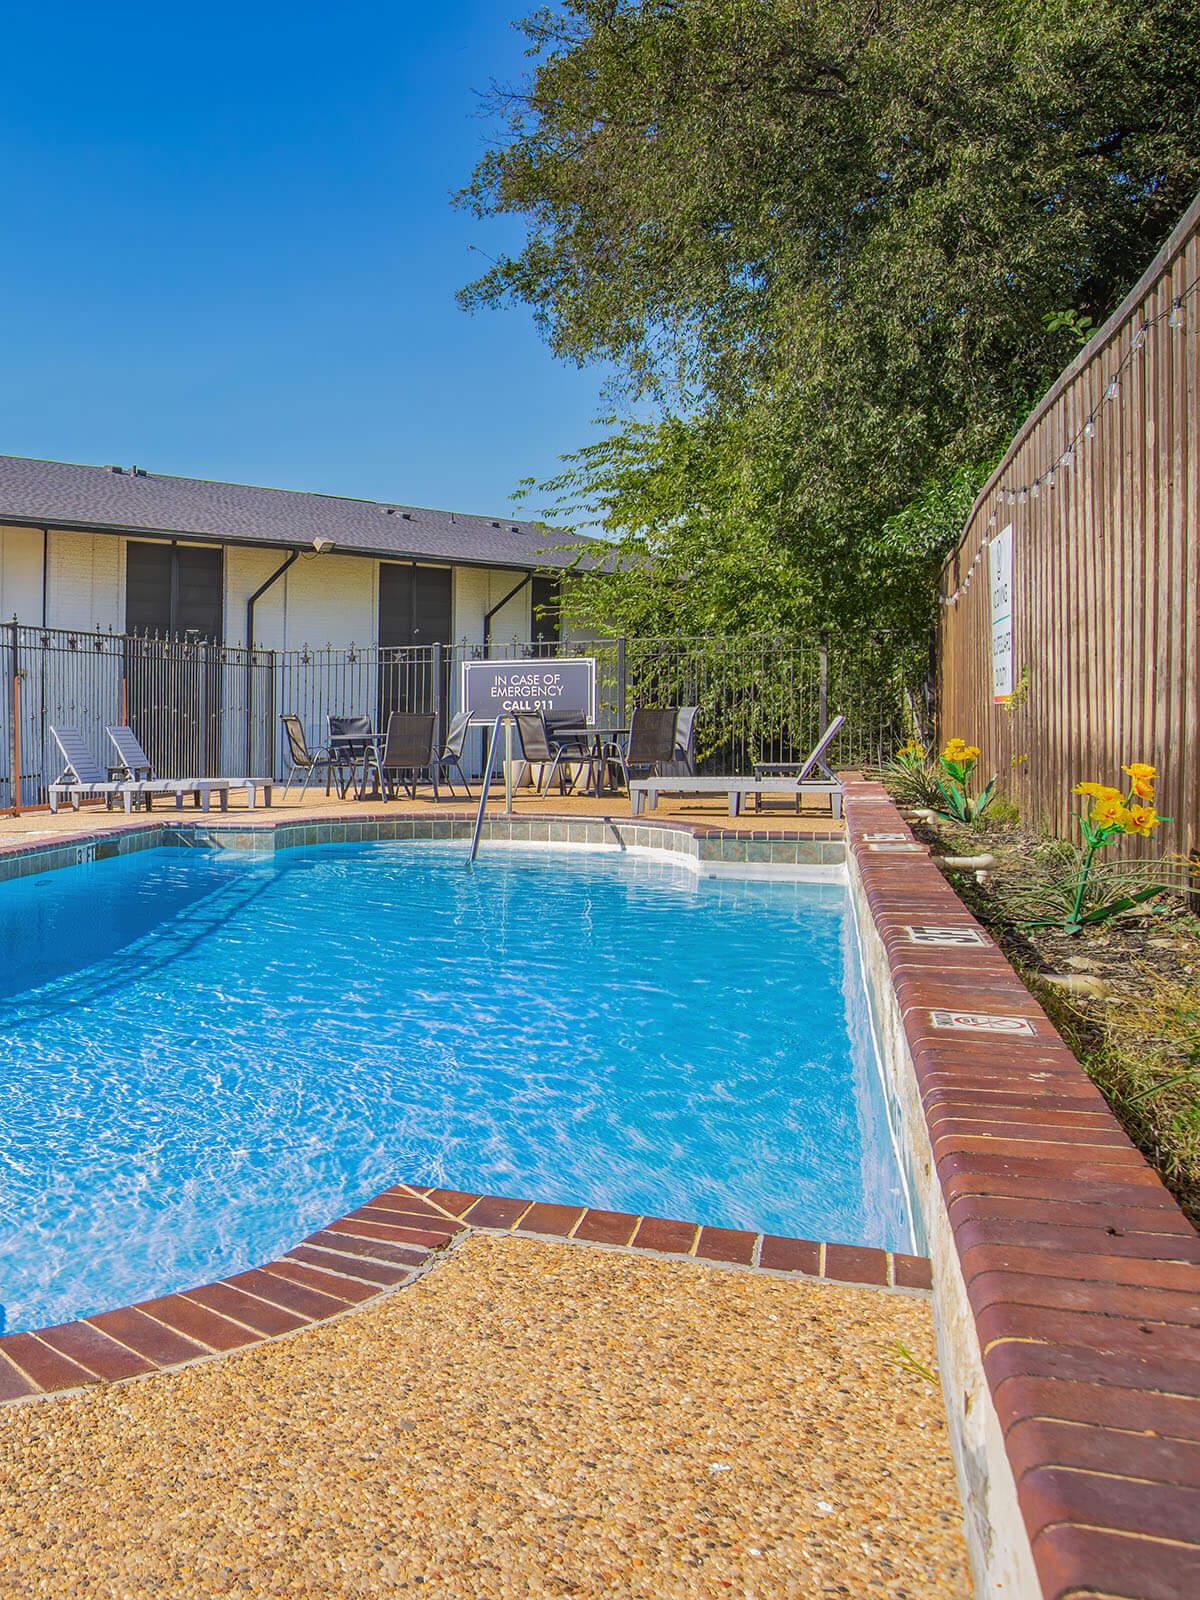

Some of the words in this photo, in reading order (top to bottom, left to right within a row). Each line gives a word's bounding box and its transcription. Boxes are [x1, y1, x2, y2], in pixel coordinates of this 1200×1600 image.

[494, 675, 506, 686] IN
[511, 674, 539, 686] CASE
[543, 674, 560, 684] OF
[490, 686, 564, 697] EMERGENCY
[502, 700, 531, 711] CALL
[534, 700, 553, 711] 911
